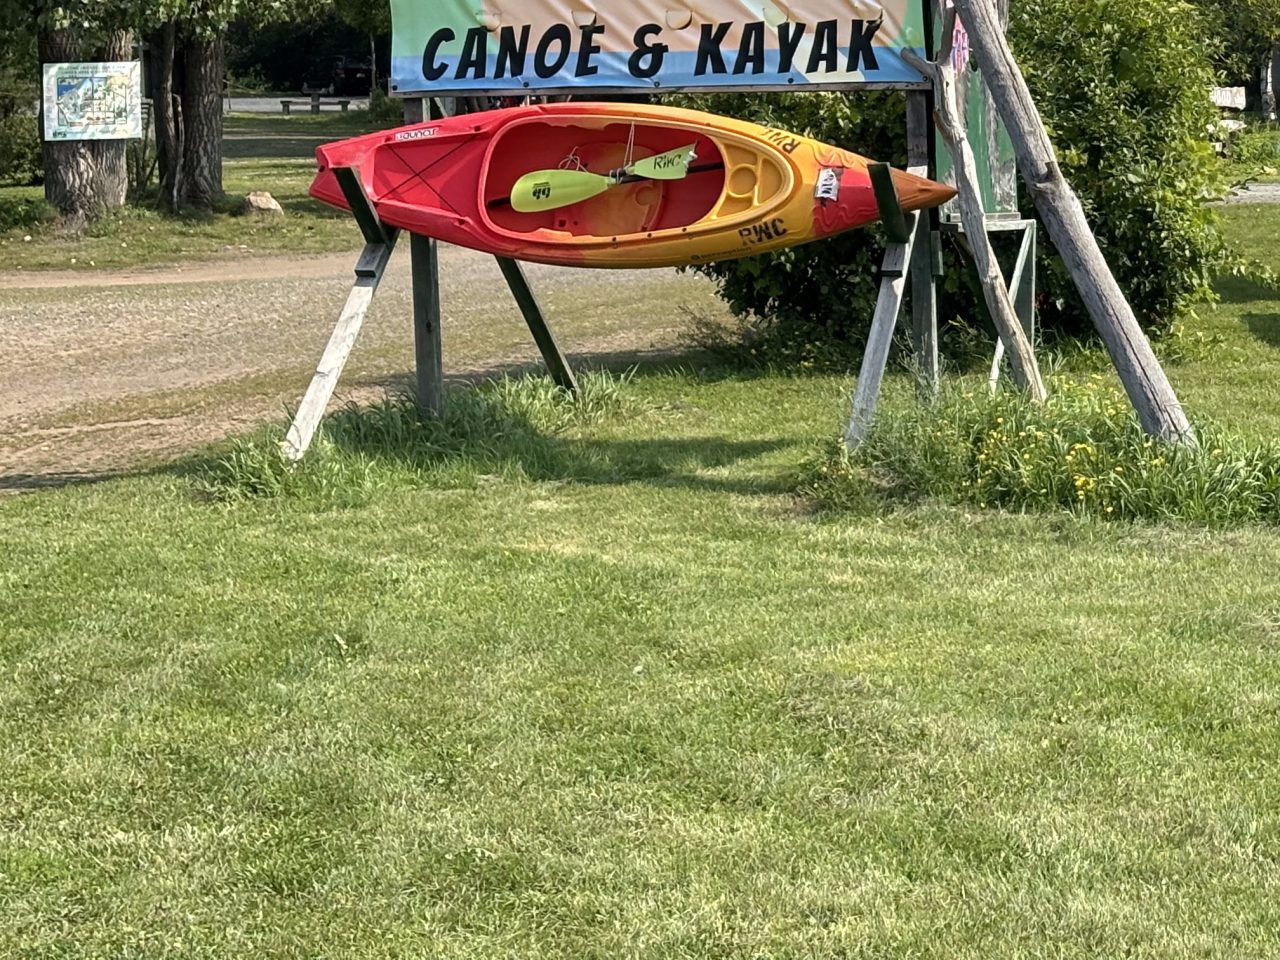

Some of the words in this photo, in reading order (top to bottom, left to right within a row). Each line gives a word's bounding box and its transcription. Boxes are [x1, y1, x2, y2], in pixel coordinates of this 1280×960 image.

[421, 23, 605, 81] CANOE
[628, 24, 668, 78] &
[695, 18, 884, 76] KAYAK
[738, 217, 787, 246] RWC
